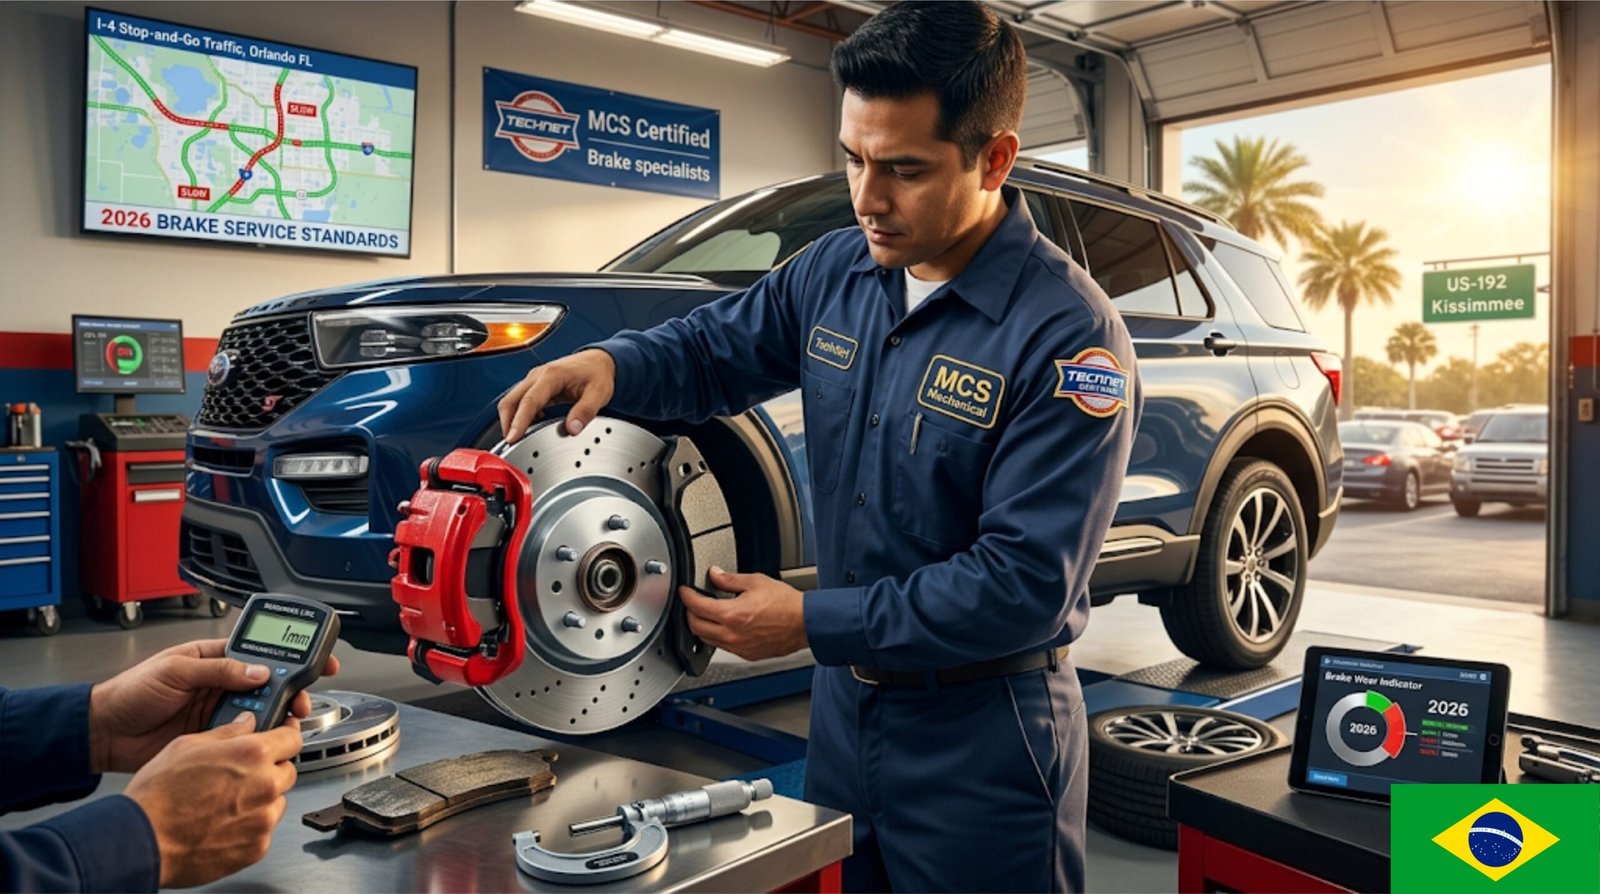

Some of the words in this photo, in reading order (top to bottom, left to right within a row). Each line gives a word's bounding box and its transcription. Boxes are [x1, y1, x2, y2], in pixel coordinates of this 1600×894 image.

[96, 17, 116, 33] I-4
[119, 22, 200, 47] Stop-and-Go
[203, 36, 246, 57] Traffic,
[250, 45, 295, 64] Orlando
[298, 55, 313, 67] FL
[506, 114, 571, 135] TECHNET
[588, 109, 632, 136] MCS
[636, 118, 711, 149] Certified
[587, 148, 632, 171] Brake
[635, 159, 711, 182] specialists
[181, 187, 207, 198] SLOW
[101, 209, 151, 229] 2026
[157, 213, 219, 234] BRAKE
[223, 219, 297, 240] SERVICE
[302, 227, 399, 249] STANDARDS
[1447, 274, 1507, 292] US-192
[1432, 298, 1525, 314] Kissimmee
[933, 365, 993, 403] MCS
[281, 624, 310, 646] 1mm
[1324, 670, 1352, 682] Brake
[1379, 677, 1423, 690] Indicator
[1427, 699, 1469, 717] 2026
[1349, 722, 1378, 735] 2026
